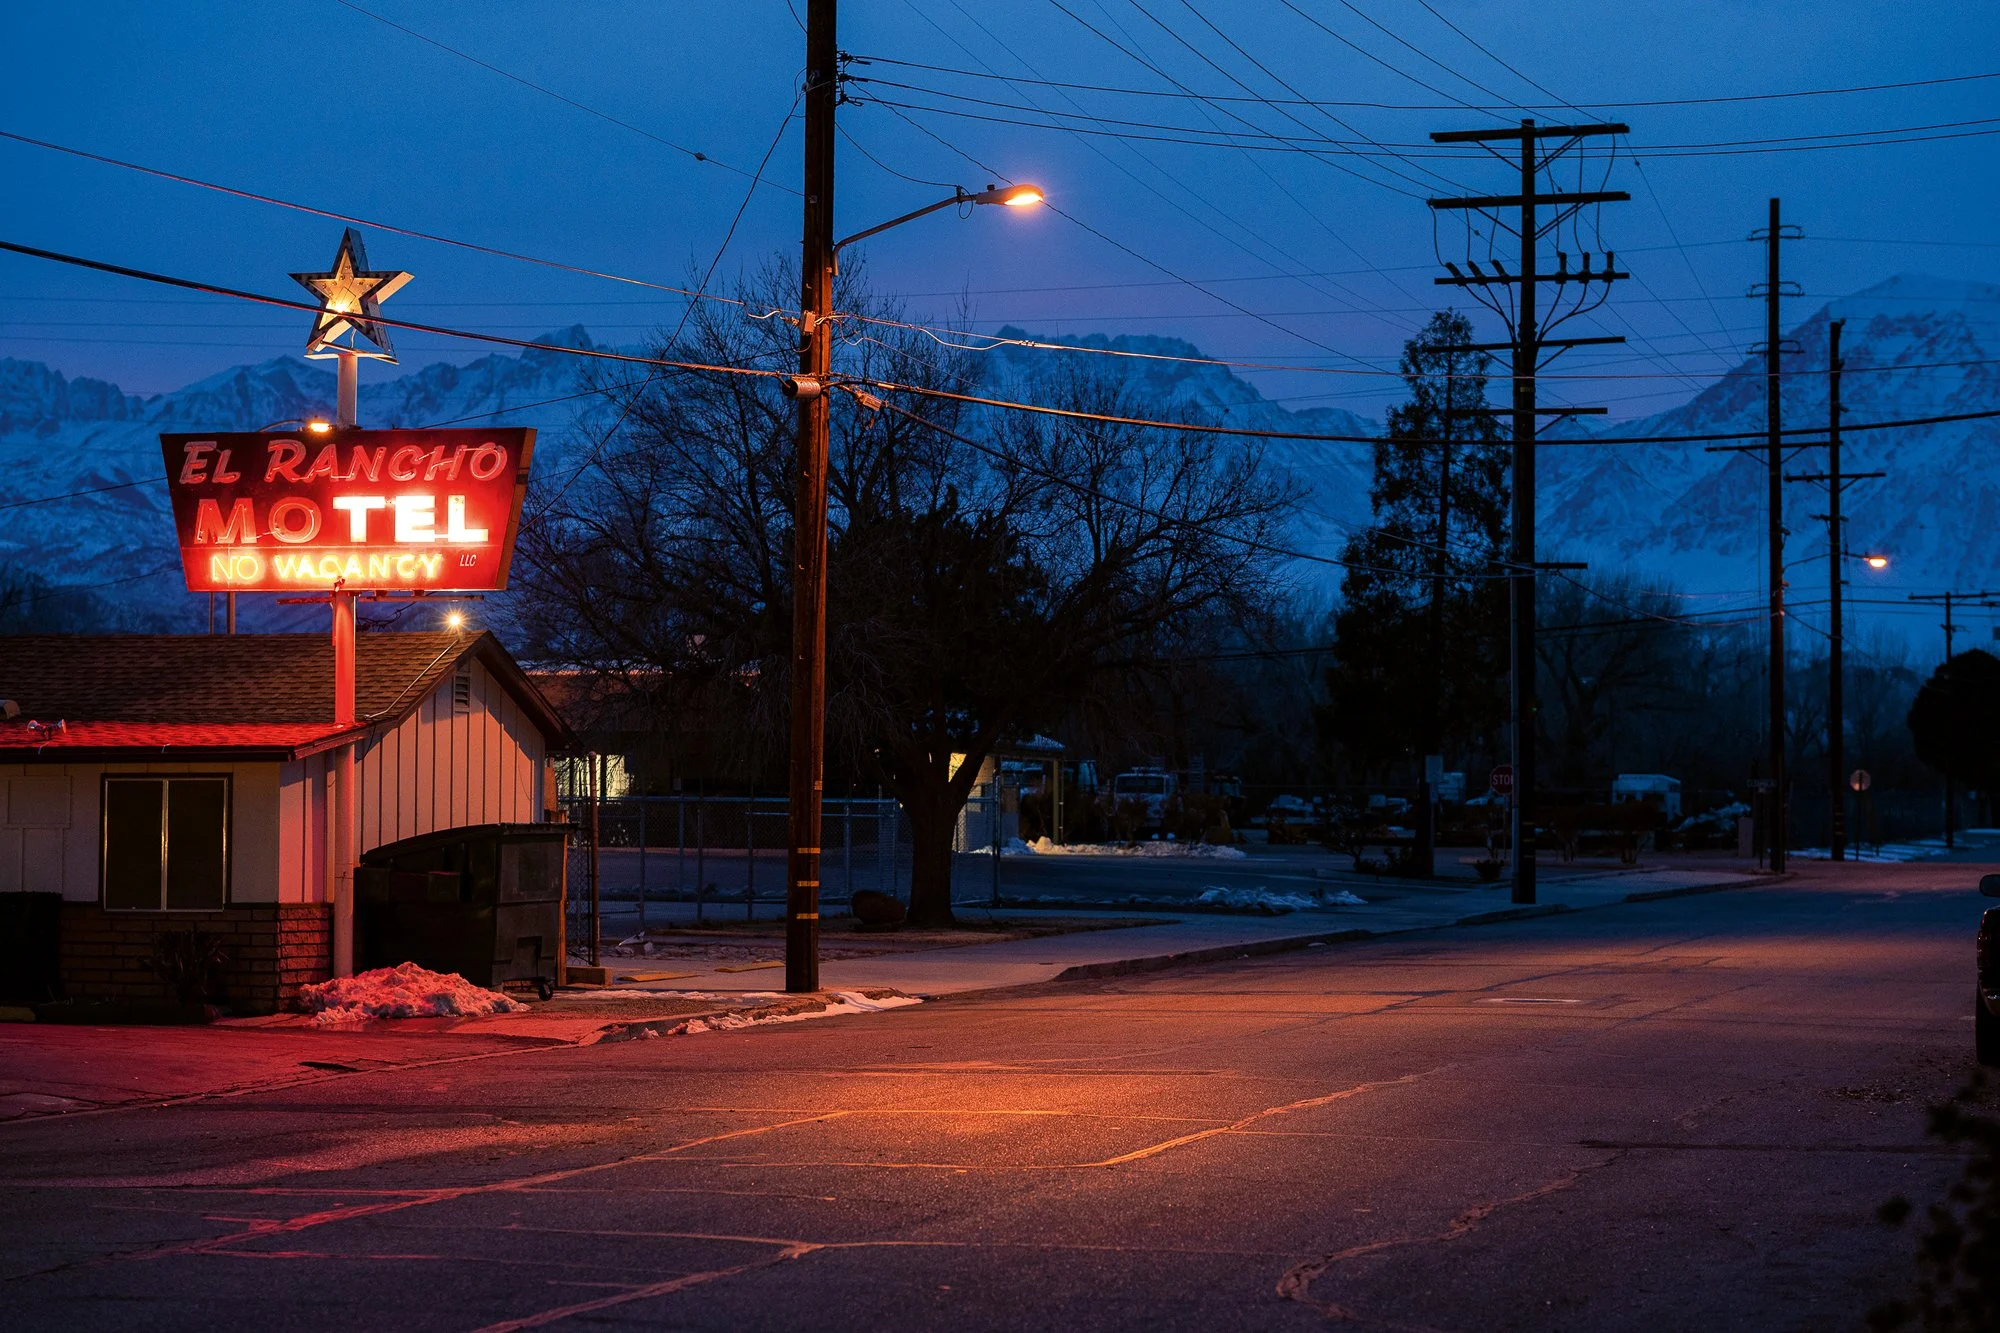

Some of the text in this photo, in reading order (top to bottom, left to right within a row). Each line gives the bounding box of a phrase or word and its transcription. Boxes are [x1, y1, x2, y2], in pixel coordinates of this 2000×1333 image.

[179, 439, 508, 484] EL RANCHO
[193, 494, 489, 544] MOTEL
[210, 552, 443, 582] NO VACANCY
[459, 553, 477, 567] LLC
